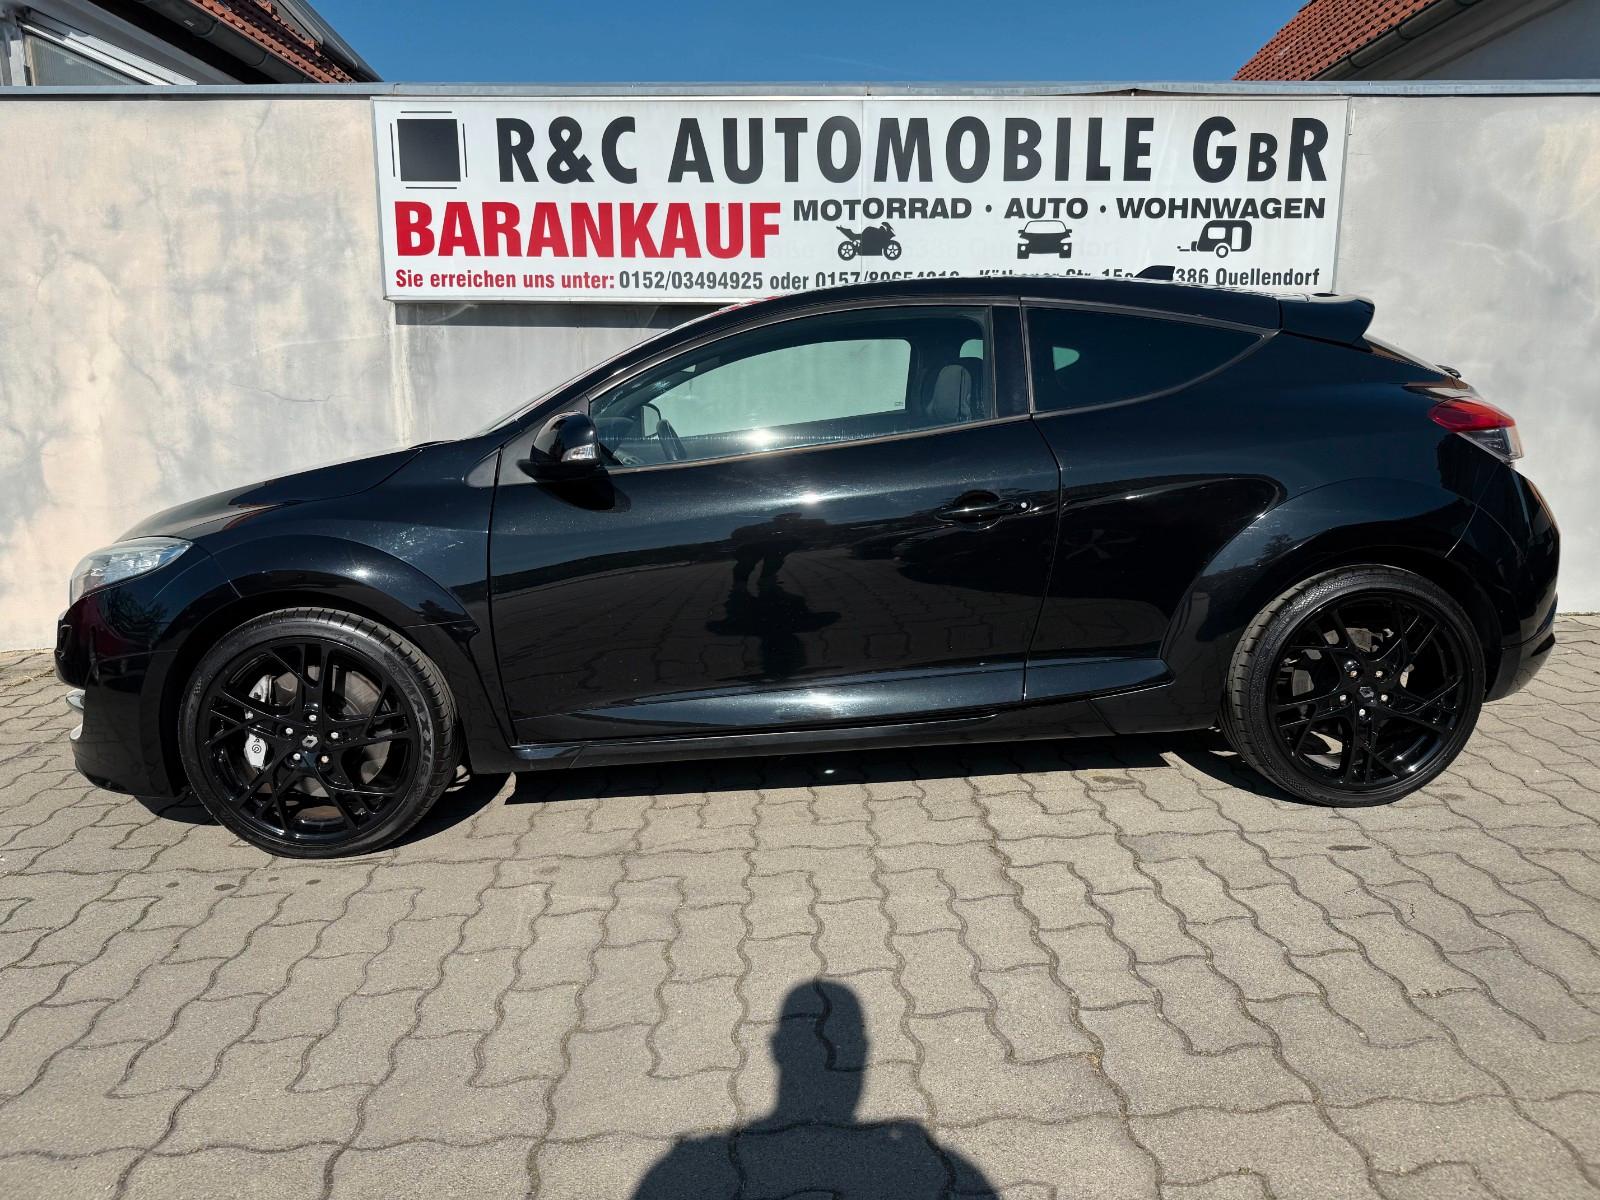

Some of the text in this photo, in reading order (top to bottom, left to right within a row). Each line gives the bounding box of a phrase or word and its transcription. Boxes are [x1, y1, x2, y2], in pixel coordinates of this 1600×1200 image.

[496, 115, 638, 184] R&C
[668, 115, 1155, 184] AUTOMOBILE
[793, 197, 1326, 221] MOTORRAD AUTO WOHNWAGEN
[394, 201, 781, 259] BARANKAUF
[395, 269, 424, 288] Sie
[430, 269, 516, 288] erreichen
[523, 273, 555, 289] uns
[561, 270, 615, 289] unter:
[619, 270, 763, 290] 0152/03494925
[769, 271, 810, 290] oder
[1215, 267, 1320, 286] Quellendorf
